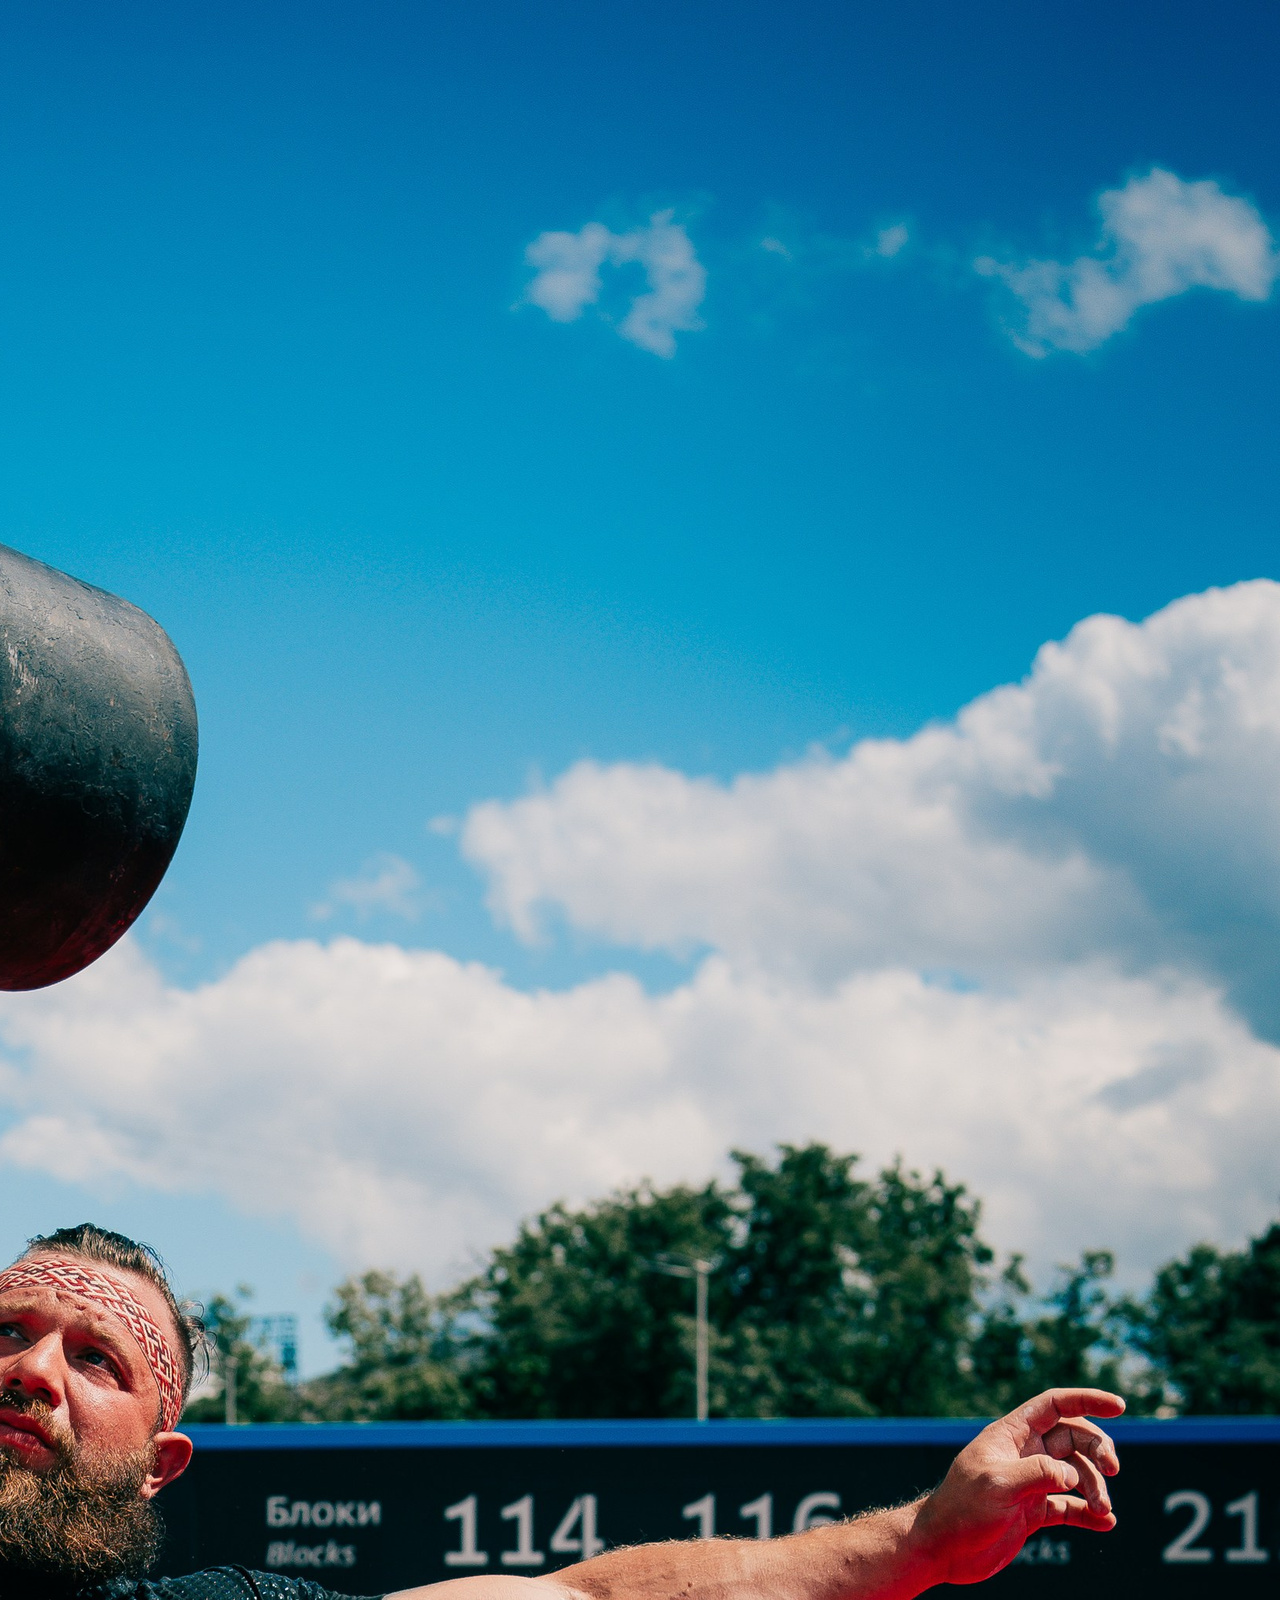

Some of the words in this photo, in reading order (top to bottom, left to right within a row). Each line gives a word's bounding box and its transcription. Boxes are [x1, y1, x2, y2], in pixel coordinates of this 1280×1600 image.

[265, 1496, 381, 1527] Блоки
[443, 1494, 605, 1567] 114
[265, 1539, 357, 1567] Blocks
[1014, 1537, 1071, 1565] cks
